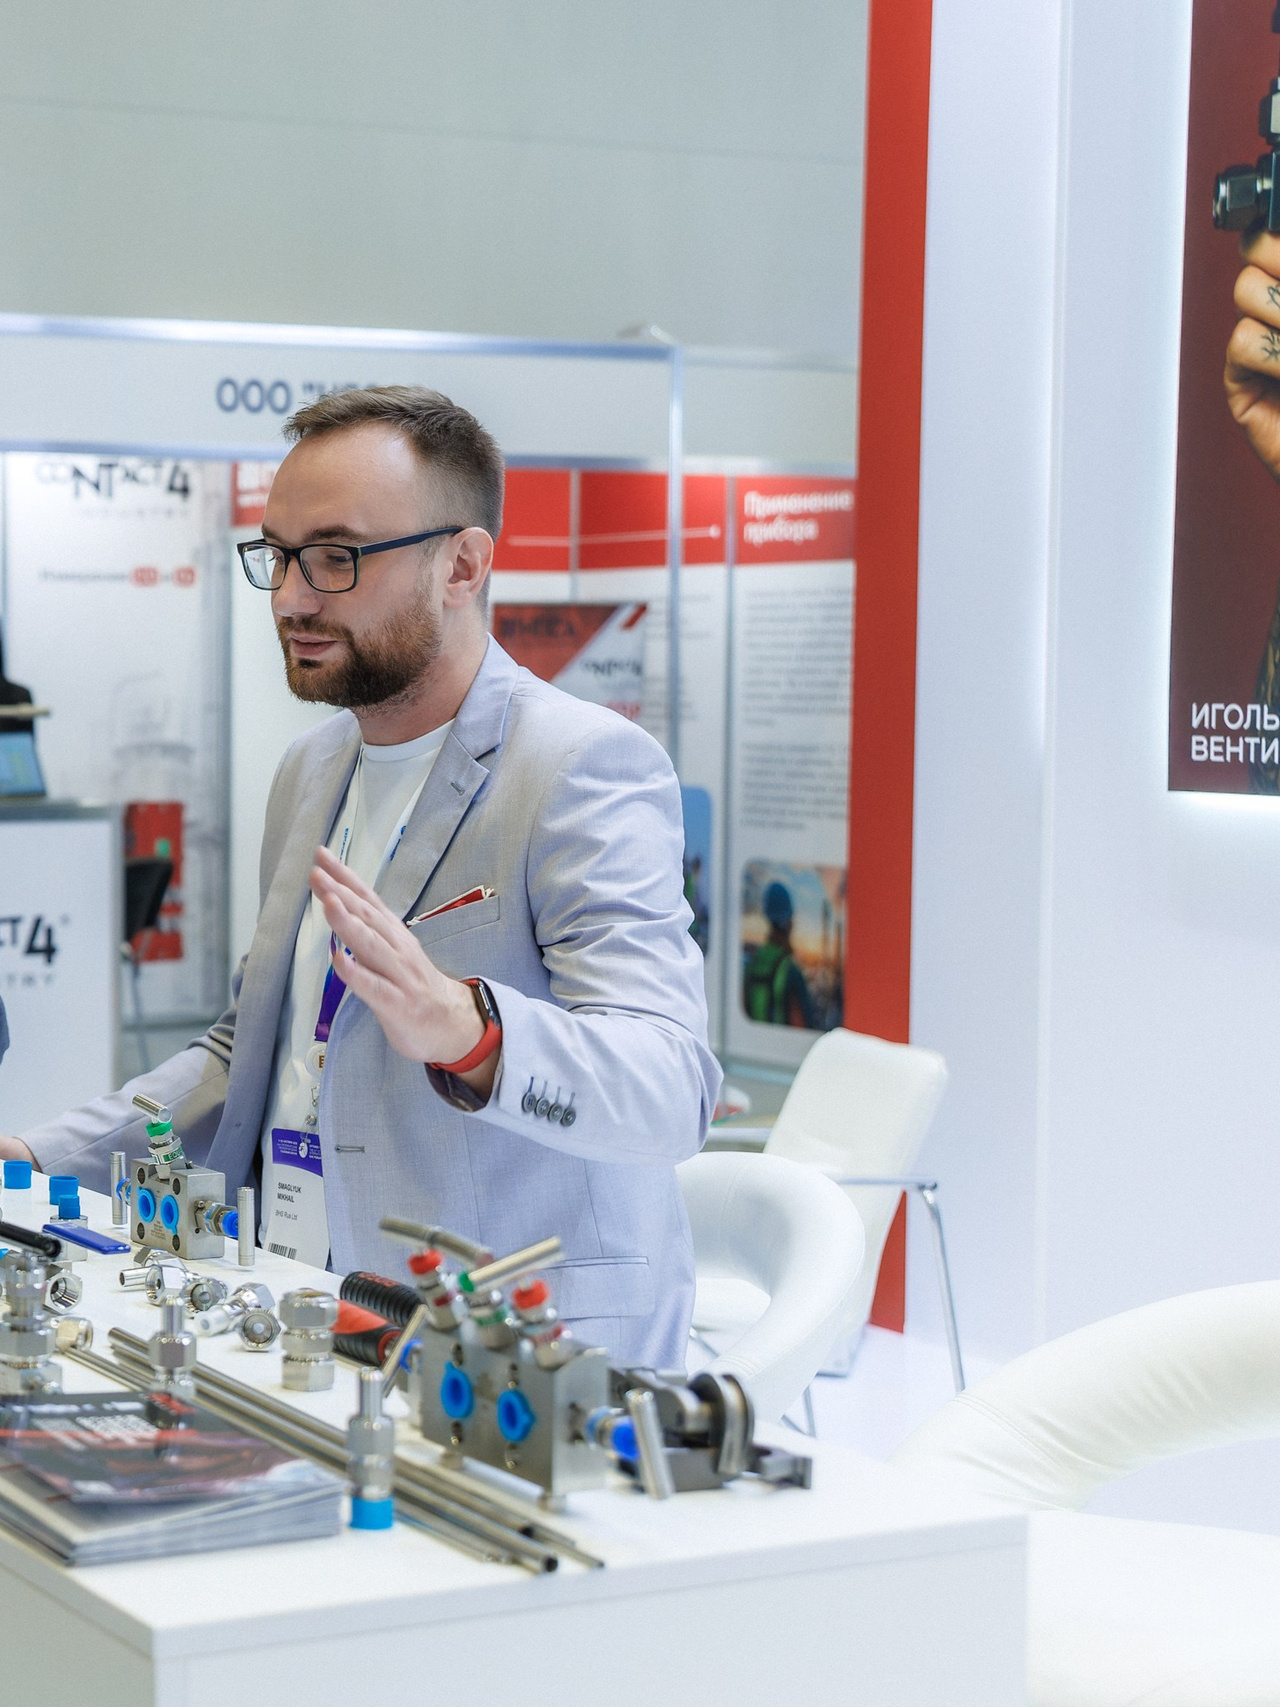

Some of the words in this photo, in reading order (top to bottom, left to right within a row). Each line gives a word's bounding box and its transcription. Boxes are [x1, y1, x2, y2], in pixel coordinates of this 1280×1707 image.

[1191, 702, 1280, 731] ИГОЛЬ
[1191, 735, 1280, 764] ВЕНТИ
[0, 915, 57, 965] T4
